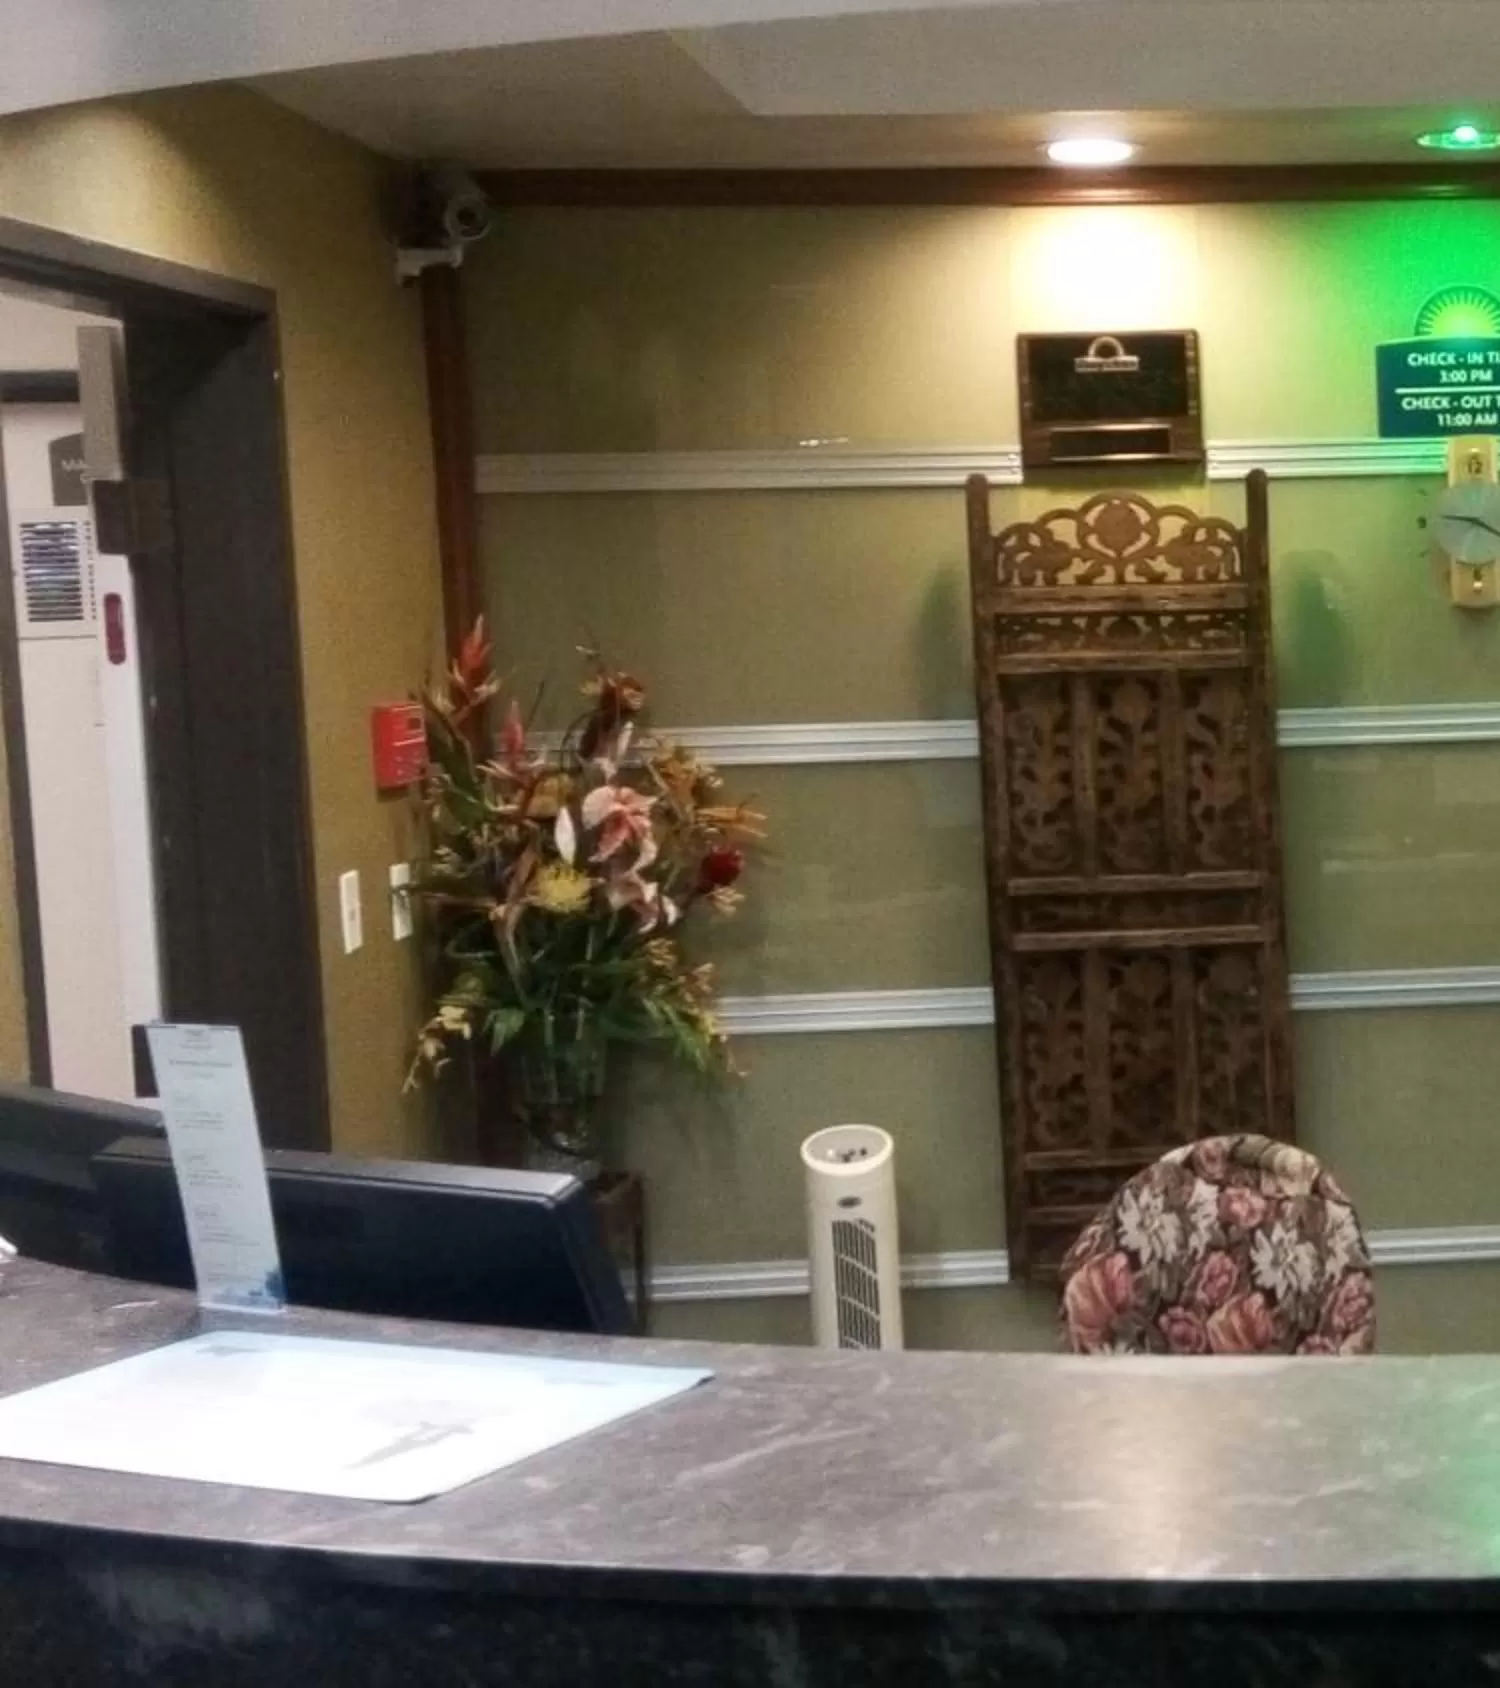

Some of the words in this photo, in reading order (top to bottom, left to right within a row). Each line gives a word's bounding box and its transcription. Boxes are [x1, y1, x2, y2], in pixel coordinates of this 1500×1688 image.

[1407, 352, 1456, 366] CHECK
[1467, 351, 1484, 364] IN
[1440, 369, 1467, 383] 3:00
[1470, 369, 1493, 382] PM
[1401, 396, 1450, 410] CHECK
[1460, 395, 1493, 409] OUT
[1437, 413, 1473, 426] 11:00
[1474, 412, 1498, 426] AM
